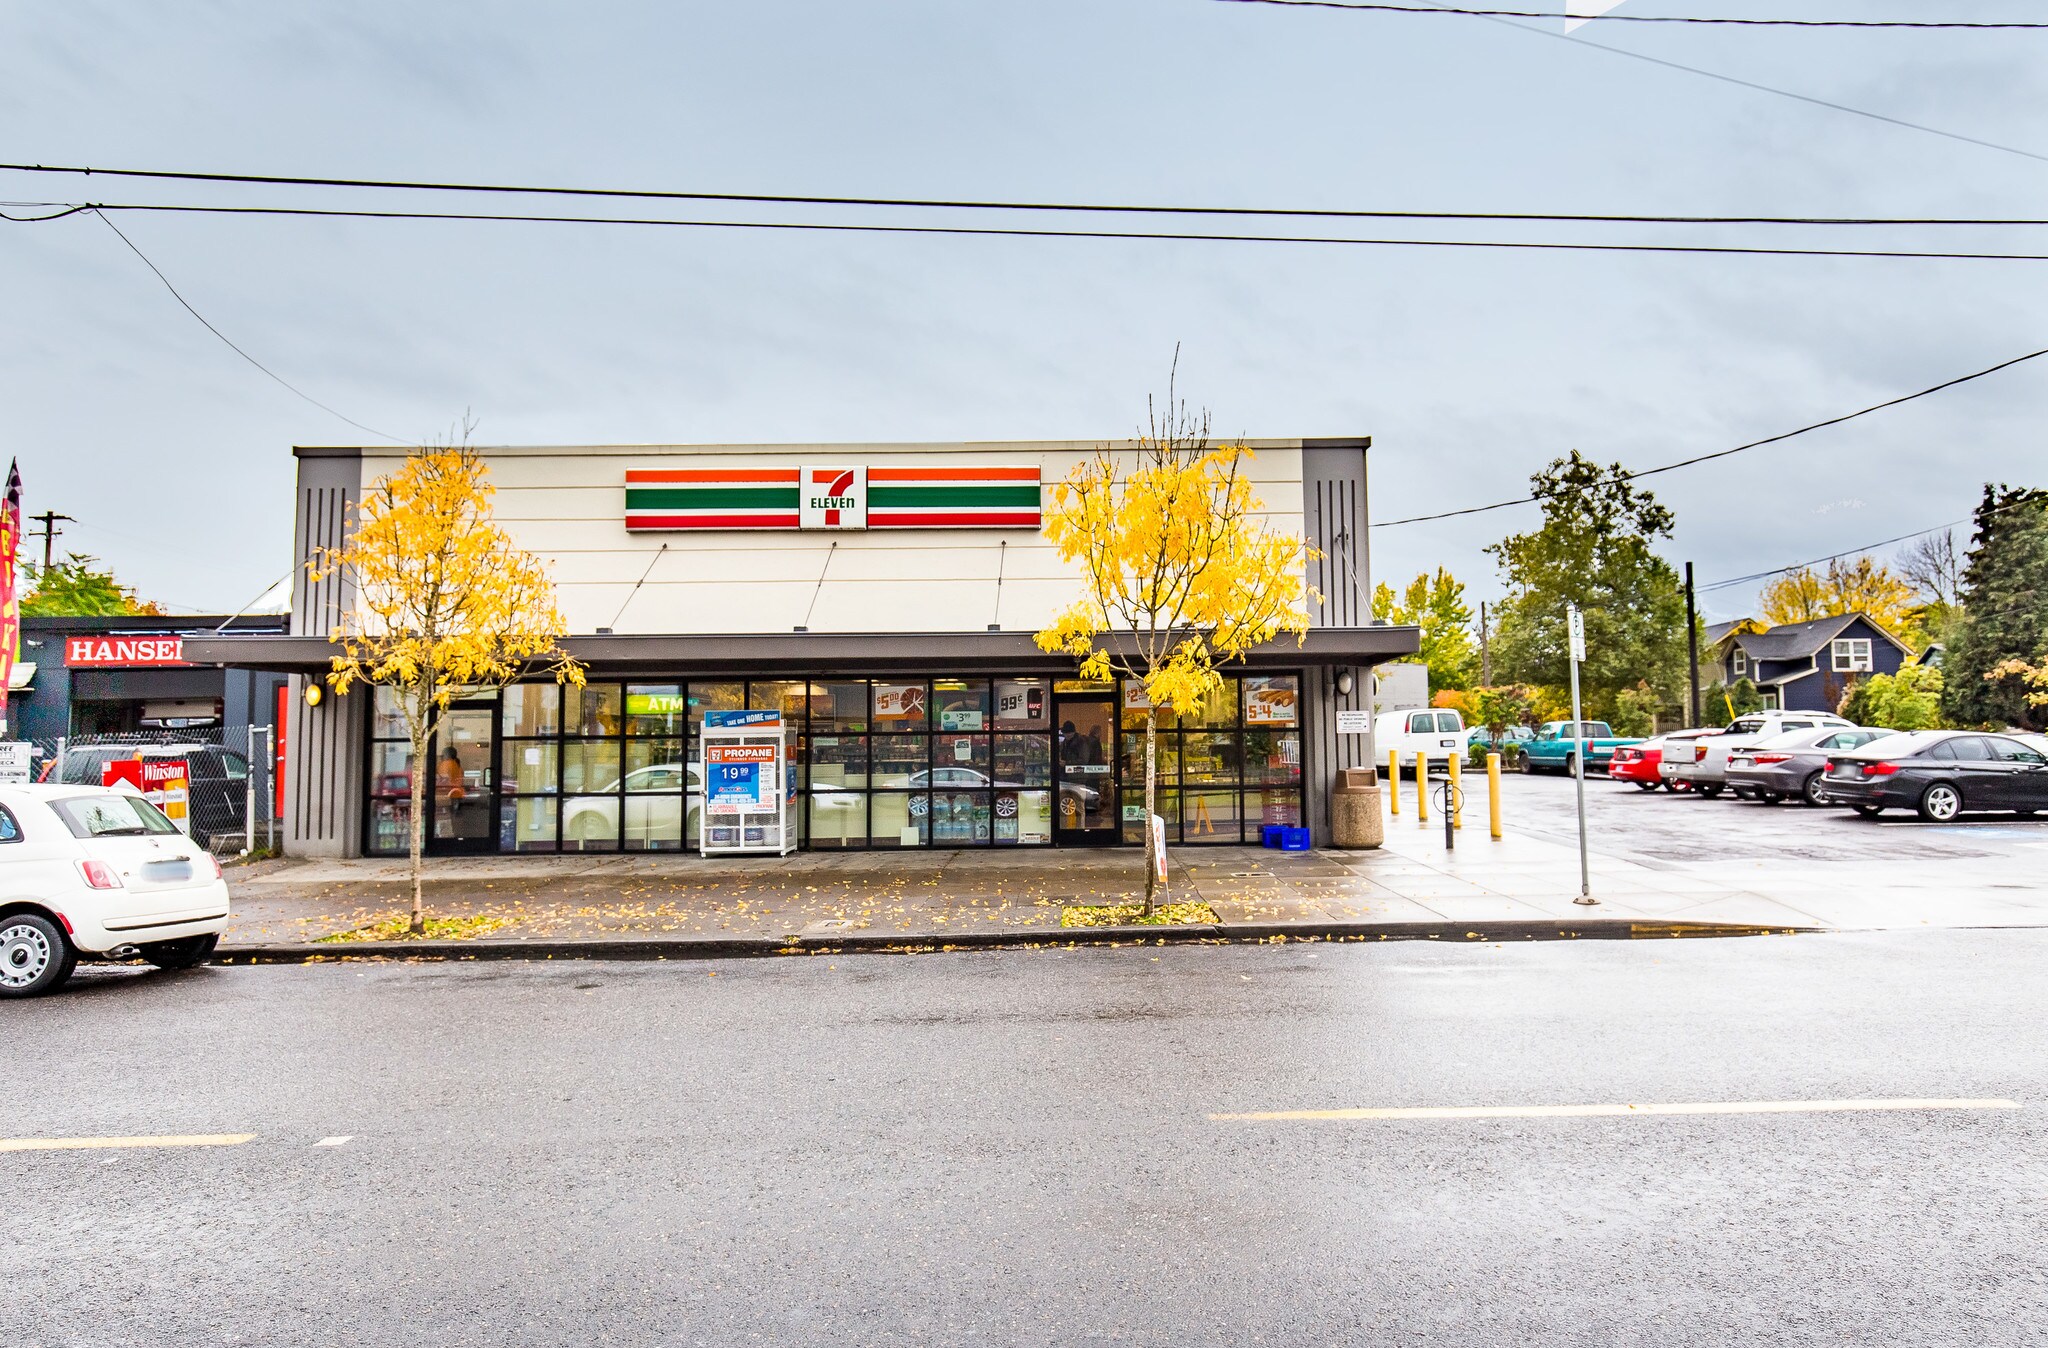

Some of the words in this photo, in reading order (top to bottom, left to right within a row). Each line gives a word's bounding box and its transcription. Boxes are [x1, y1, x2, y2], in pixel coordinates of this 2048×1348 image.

[648, 697, 683, 711] ATM
[746, 713, 764, 722] HOME
[725, 749, 772, 757] PROPANE
[144, 764, 184, 781] Winston
